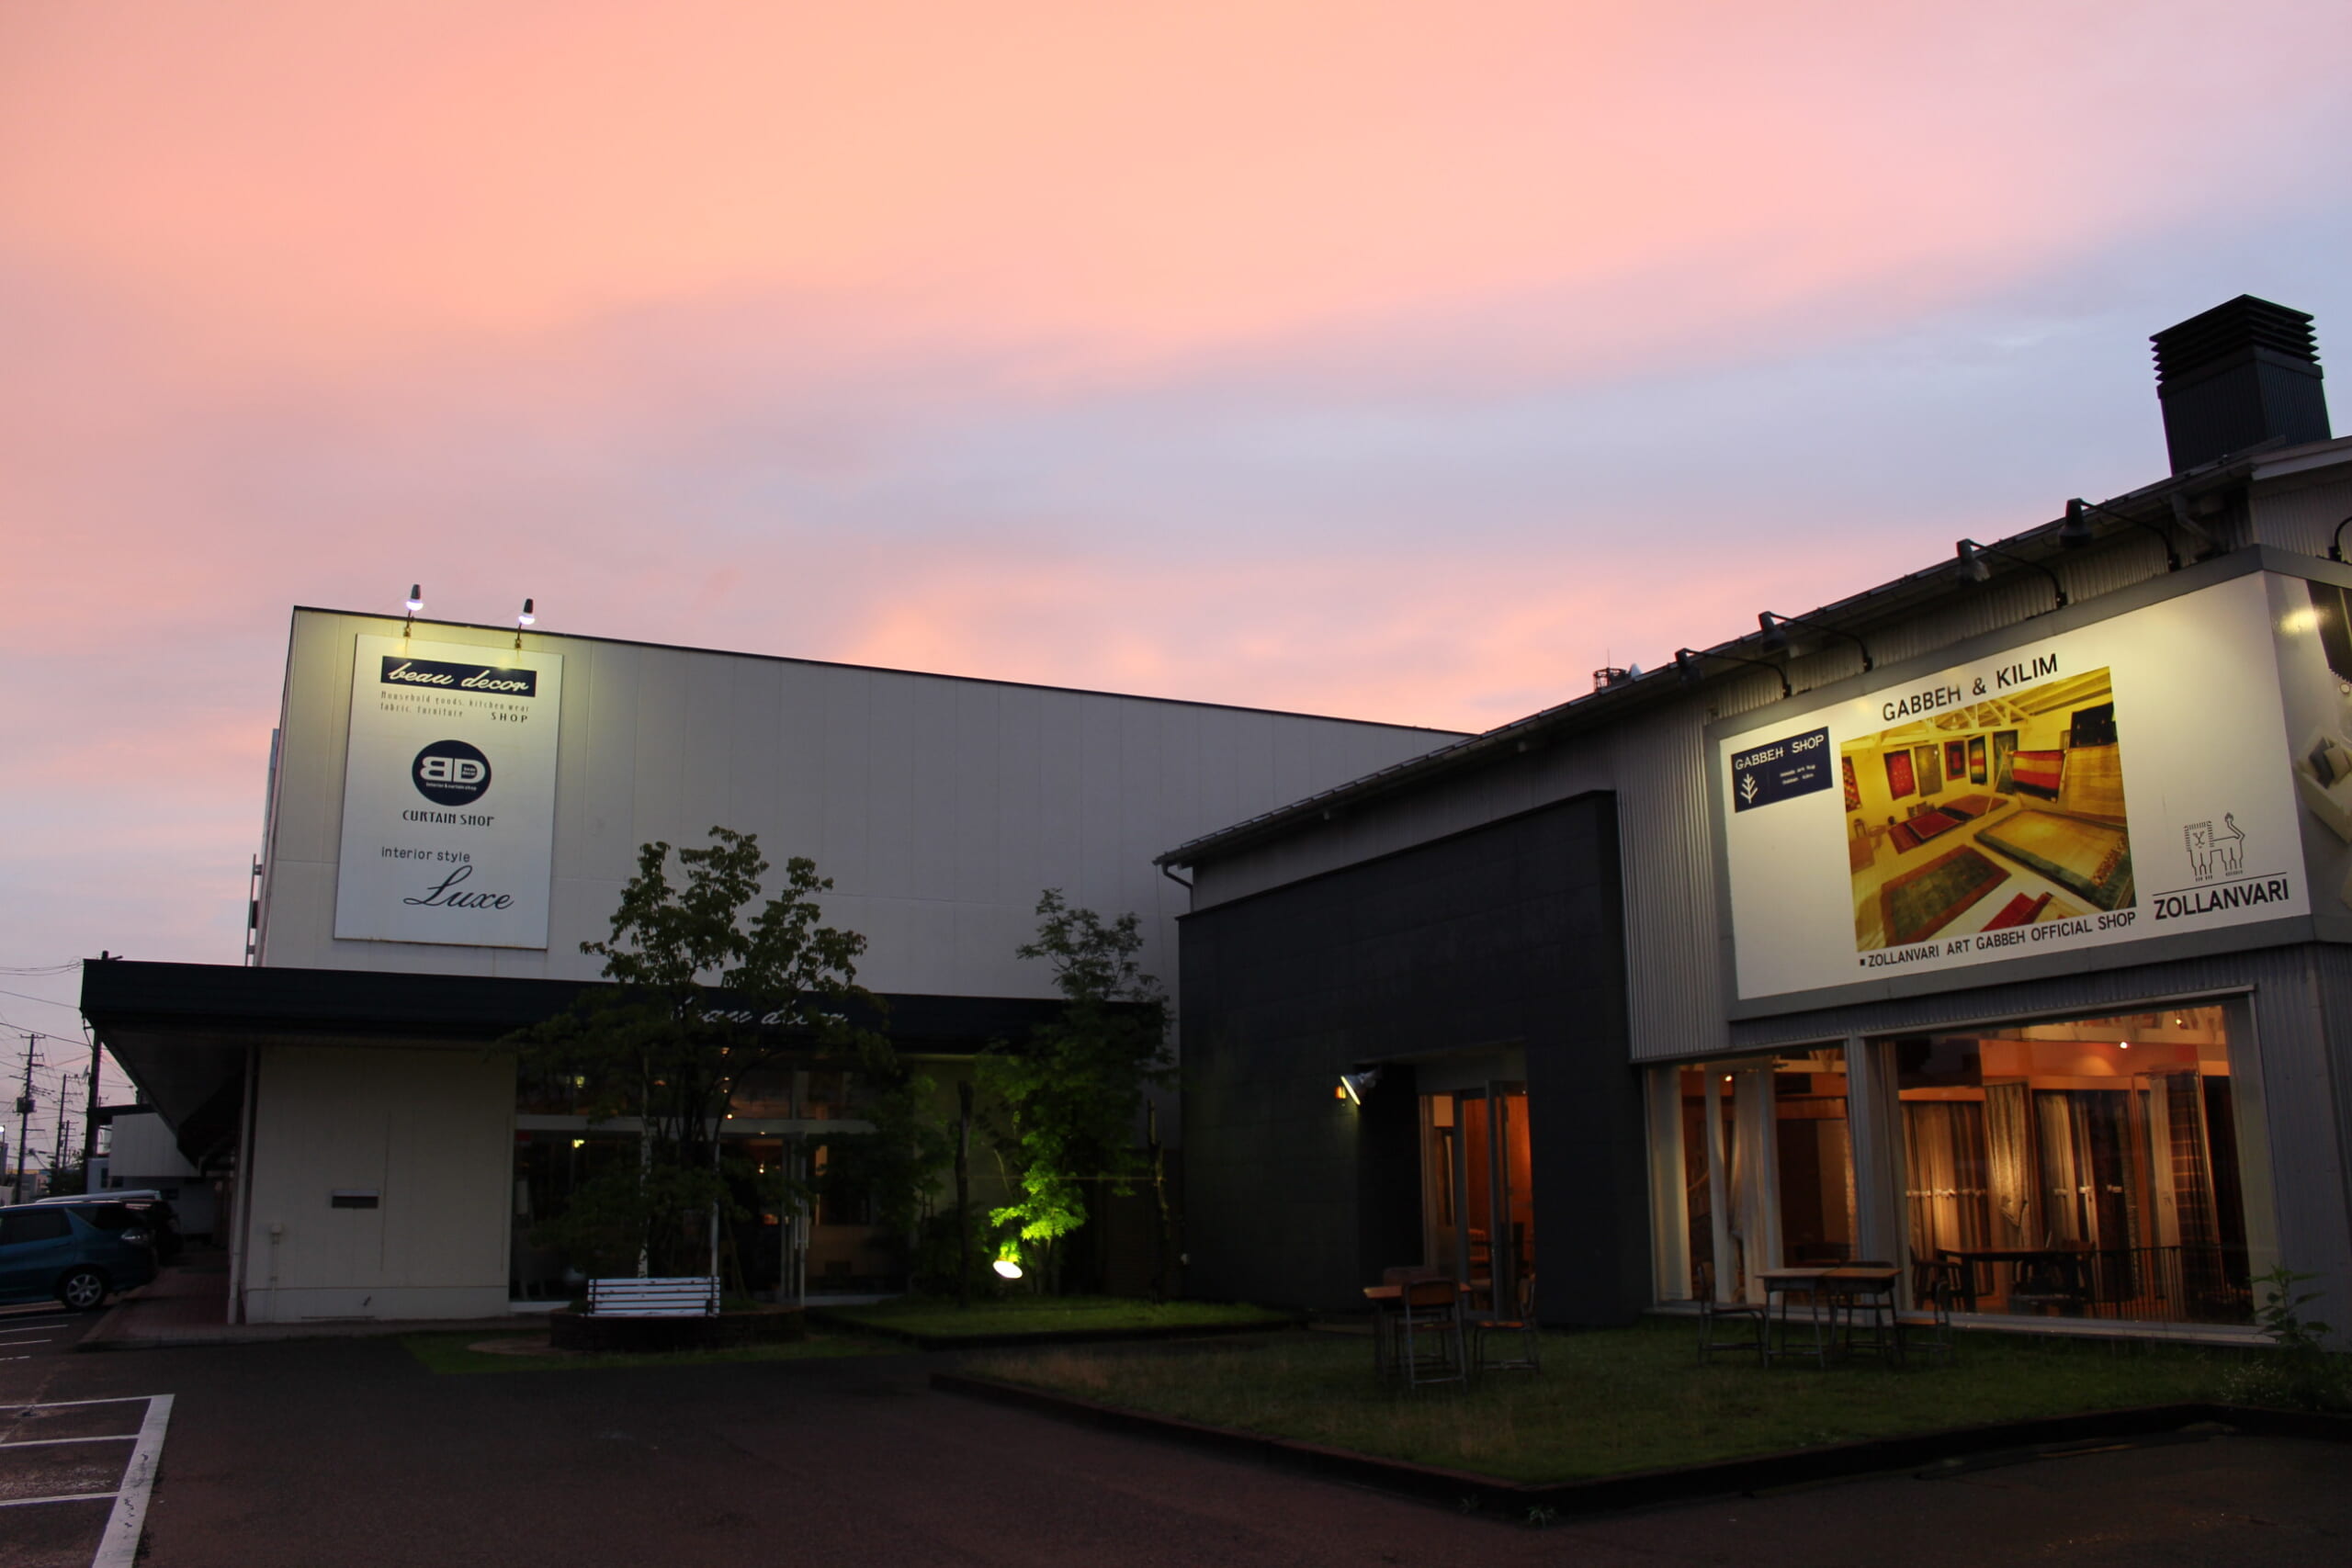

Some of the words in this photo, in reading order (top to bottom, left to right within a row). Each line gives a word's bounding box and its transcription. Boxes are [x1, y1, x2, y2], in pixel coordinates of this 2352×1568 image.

[388, 661, 454, 685] beau
[460, 670, 529, 692] decor
[1883, 683, 1962, 722] GABBEH
[1972, 677, 1986, 696] &
[1996, 653, 2058, 689] KILIM
[491, 712, 528, 724] SHOP
[1735, 746, 1784, 771] GABBEH
[1791, 734, 1825, 753] SHOP
[402, 809, 457, 824] CURTAIN
[460, 814, 495, 827] SHOP
[381, 846, 433, 861] interior
[436, 851, 470, 863] style
[402, 864, 514, 910] Luxe
[2154, 878, 2290, 920] ZOLLANVARI
[1868, 944, 1939, 968] ZOLLANVARI
[1946, 939, 1972, 956] ART
[1975, 930, 2025, 950] GABBEH
[2030, 919, 2093, 942] OFFICIAL
[2098, 911, 2136, 931] SHOP
